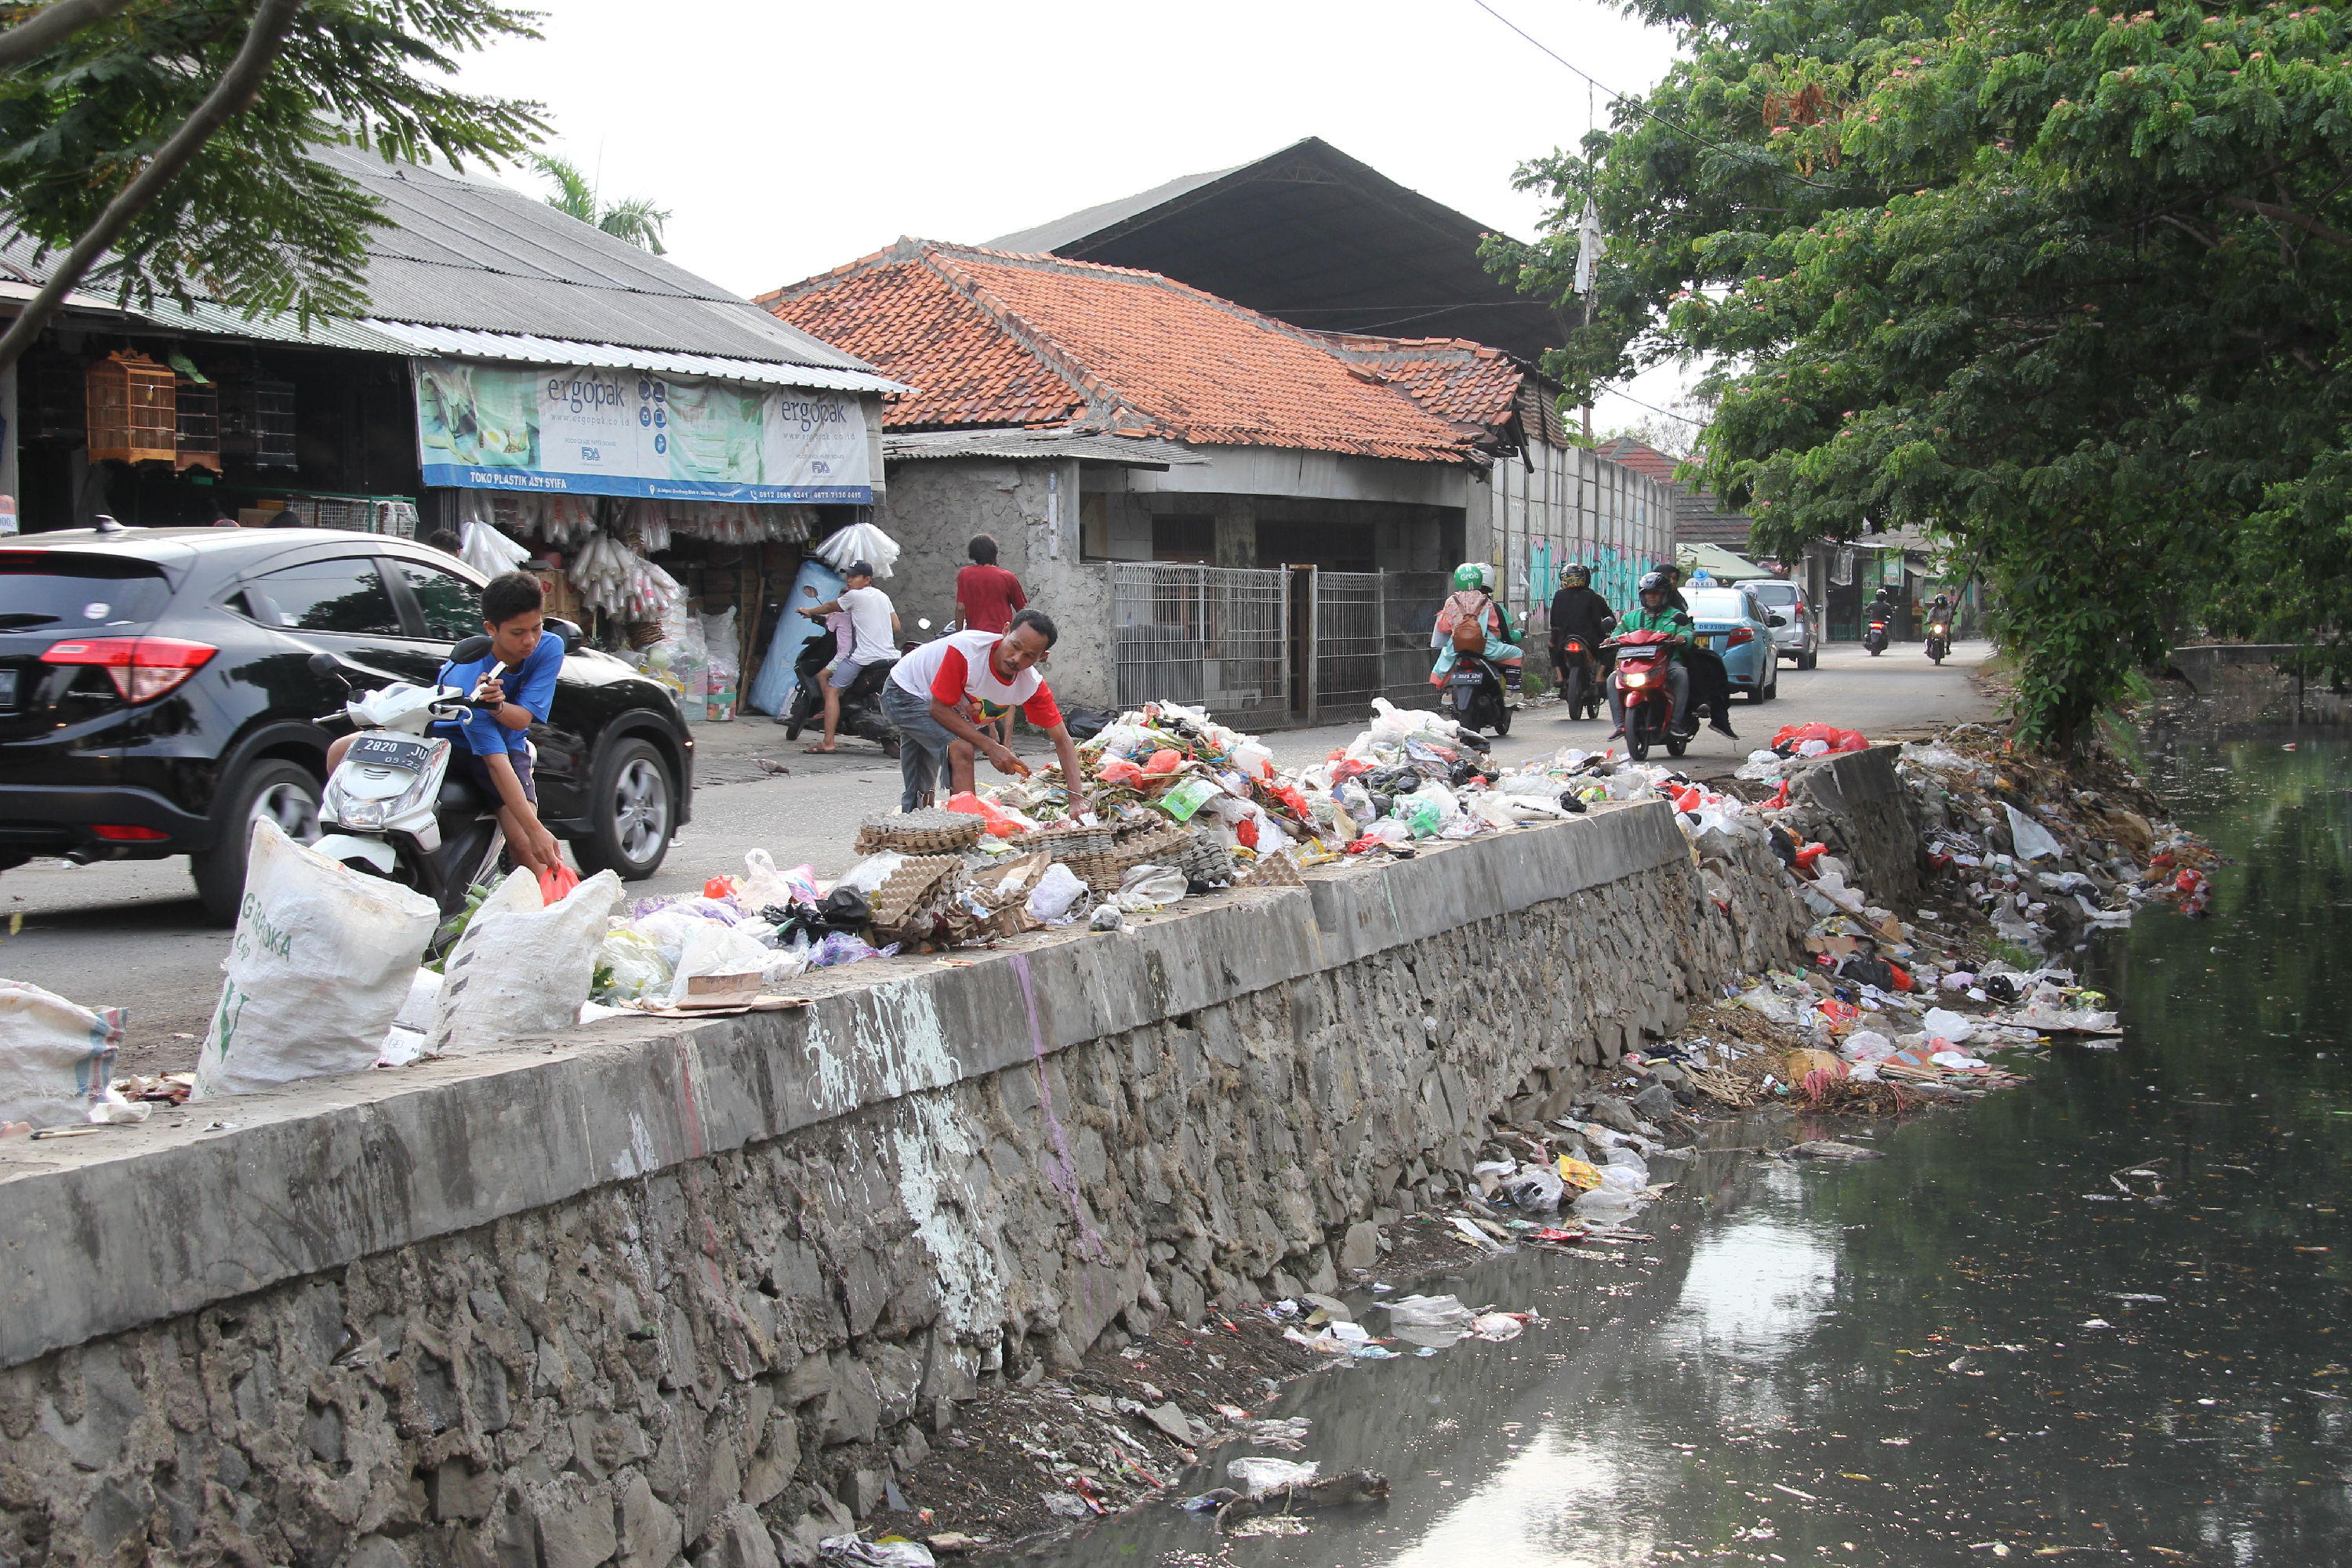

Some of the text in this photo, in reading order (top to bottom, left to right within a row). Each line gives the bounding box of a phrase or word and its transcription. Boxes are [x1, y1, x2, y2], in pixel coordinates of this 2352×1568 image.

[548, 376, 625, 414] ergopak
[551, 414, 630, 426] www.ergopak.co.id
[782, 397, 848, 432] ergopak
[582, 447, 601, 461] FDA
[811, 461, 831, 474] FDA
[470, 471, 567, 489] TOKO PLASTIK ASY SYIFA
[1460, 572, 1479, 580] Grab
[364, 739, 398, 753] 2820
[410, 746, 428, 760] JU
[418, 820, 437, 835] HONDA
